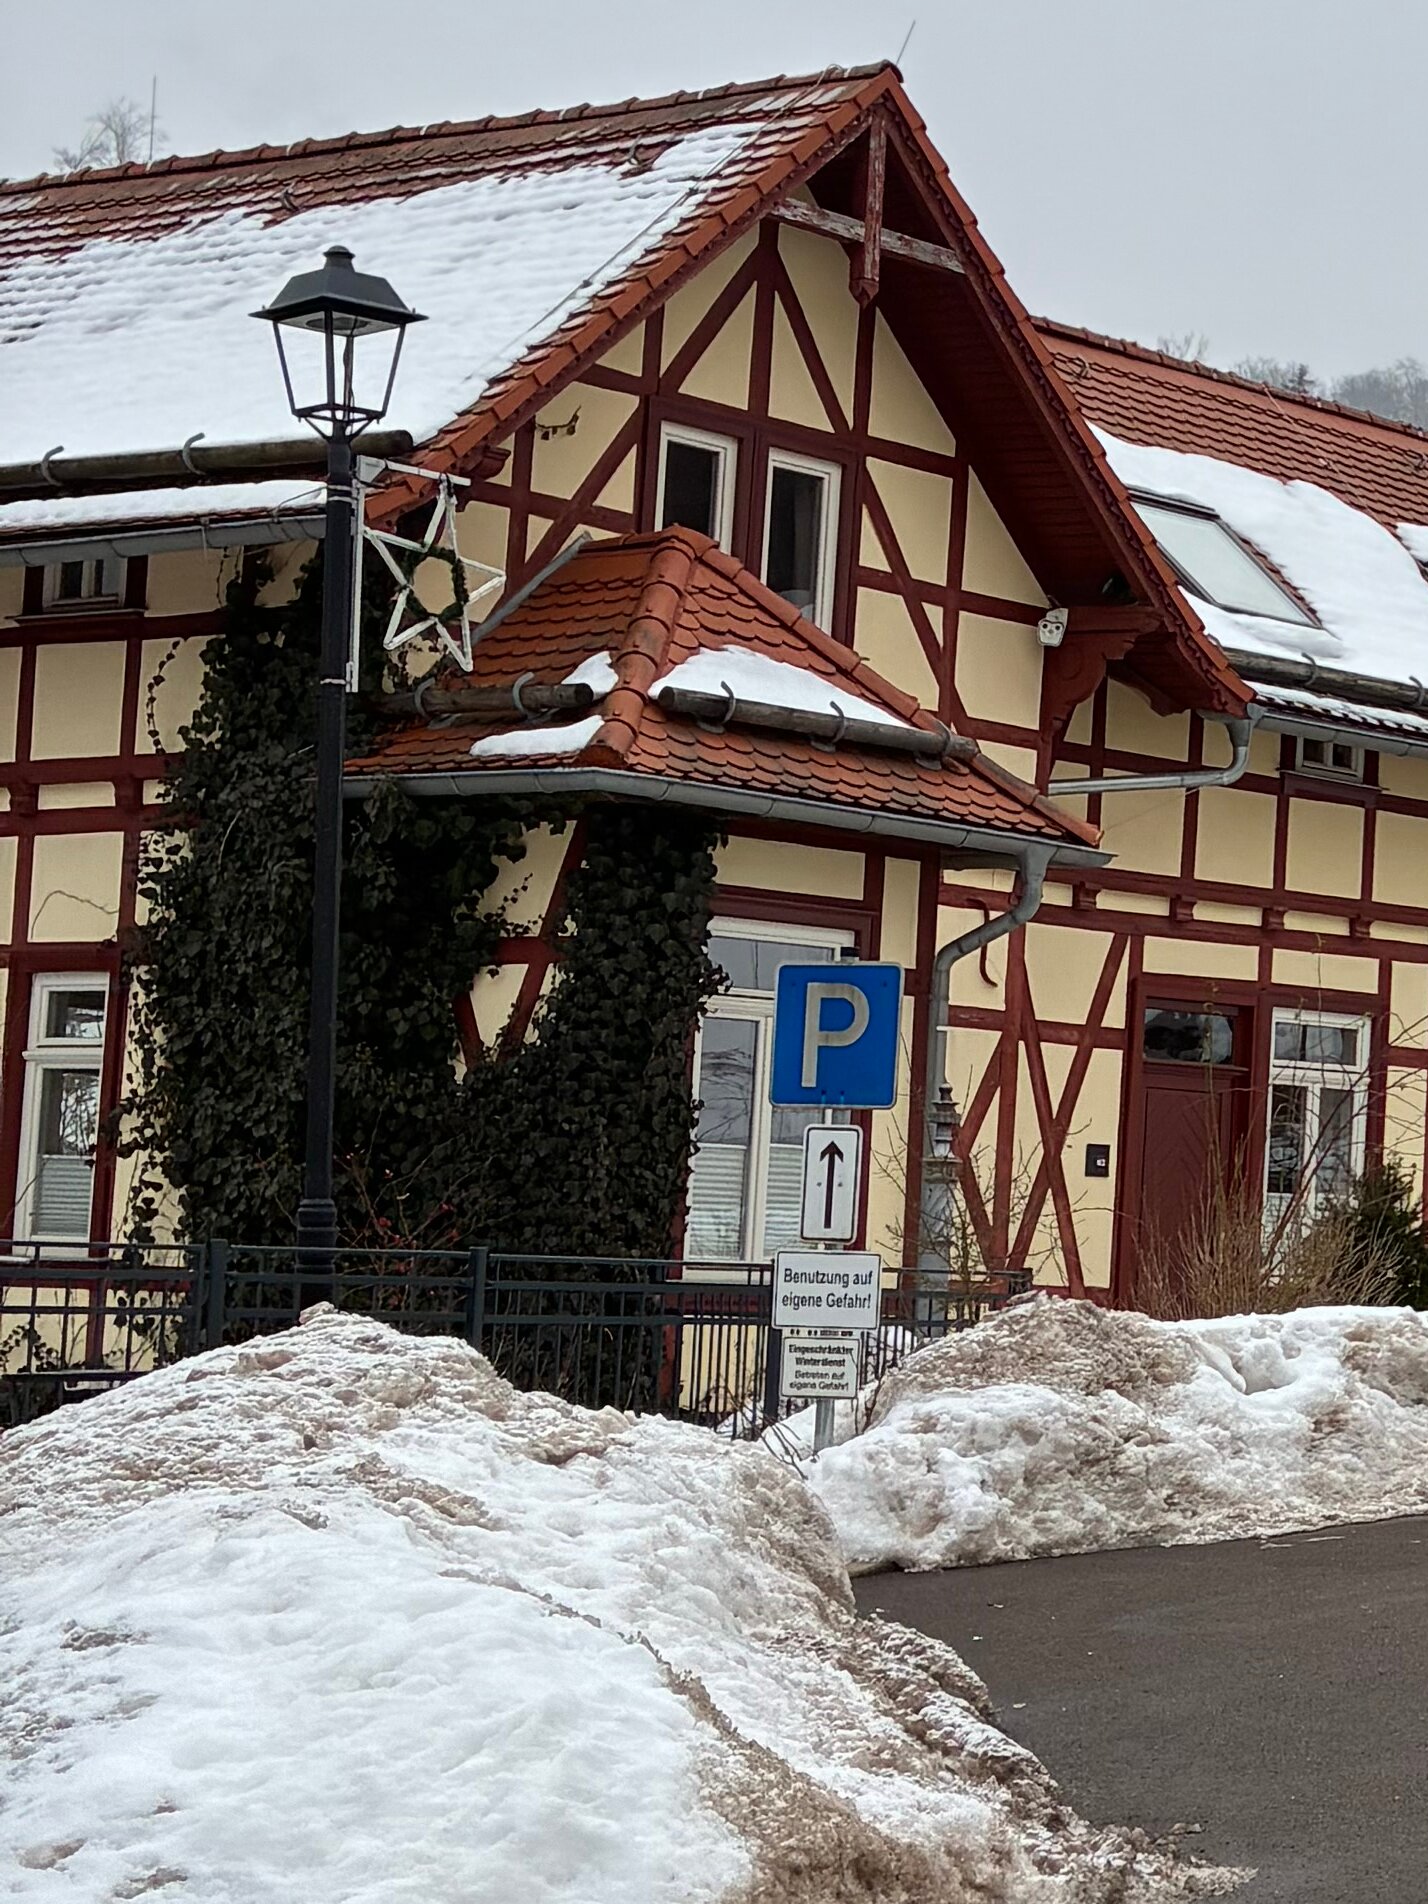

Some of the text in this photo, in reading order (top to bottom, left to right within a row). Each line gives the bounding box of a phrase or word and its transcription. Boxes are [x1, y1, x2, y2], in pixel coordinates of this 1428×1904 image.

[801, 981, 870, 1088] P
[784, 1268, 873, 1288] Benutzung auf
[782, 1291, 871, 1310] eigene Gefahr!
